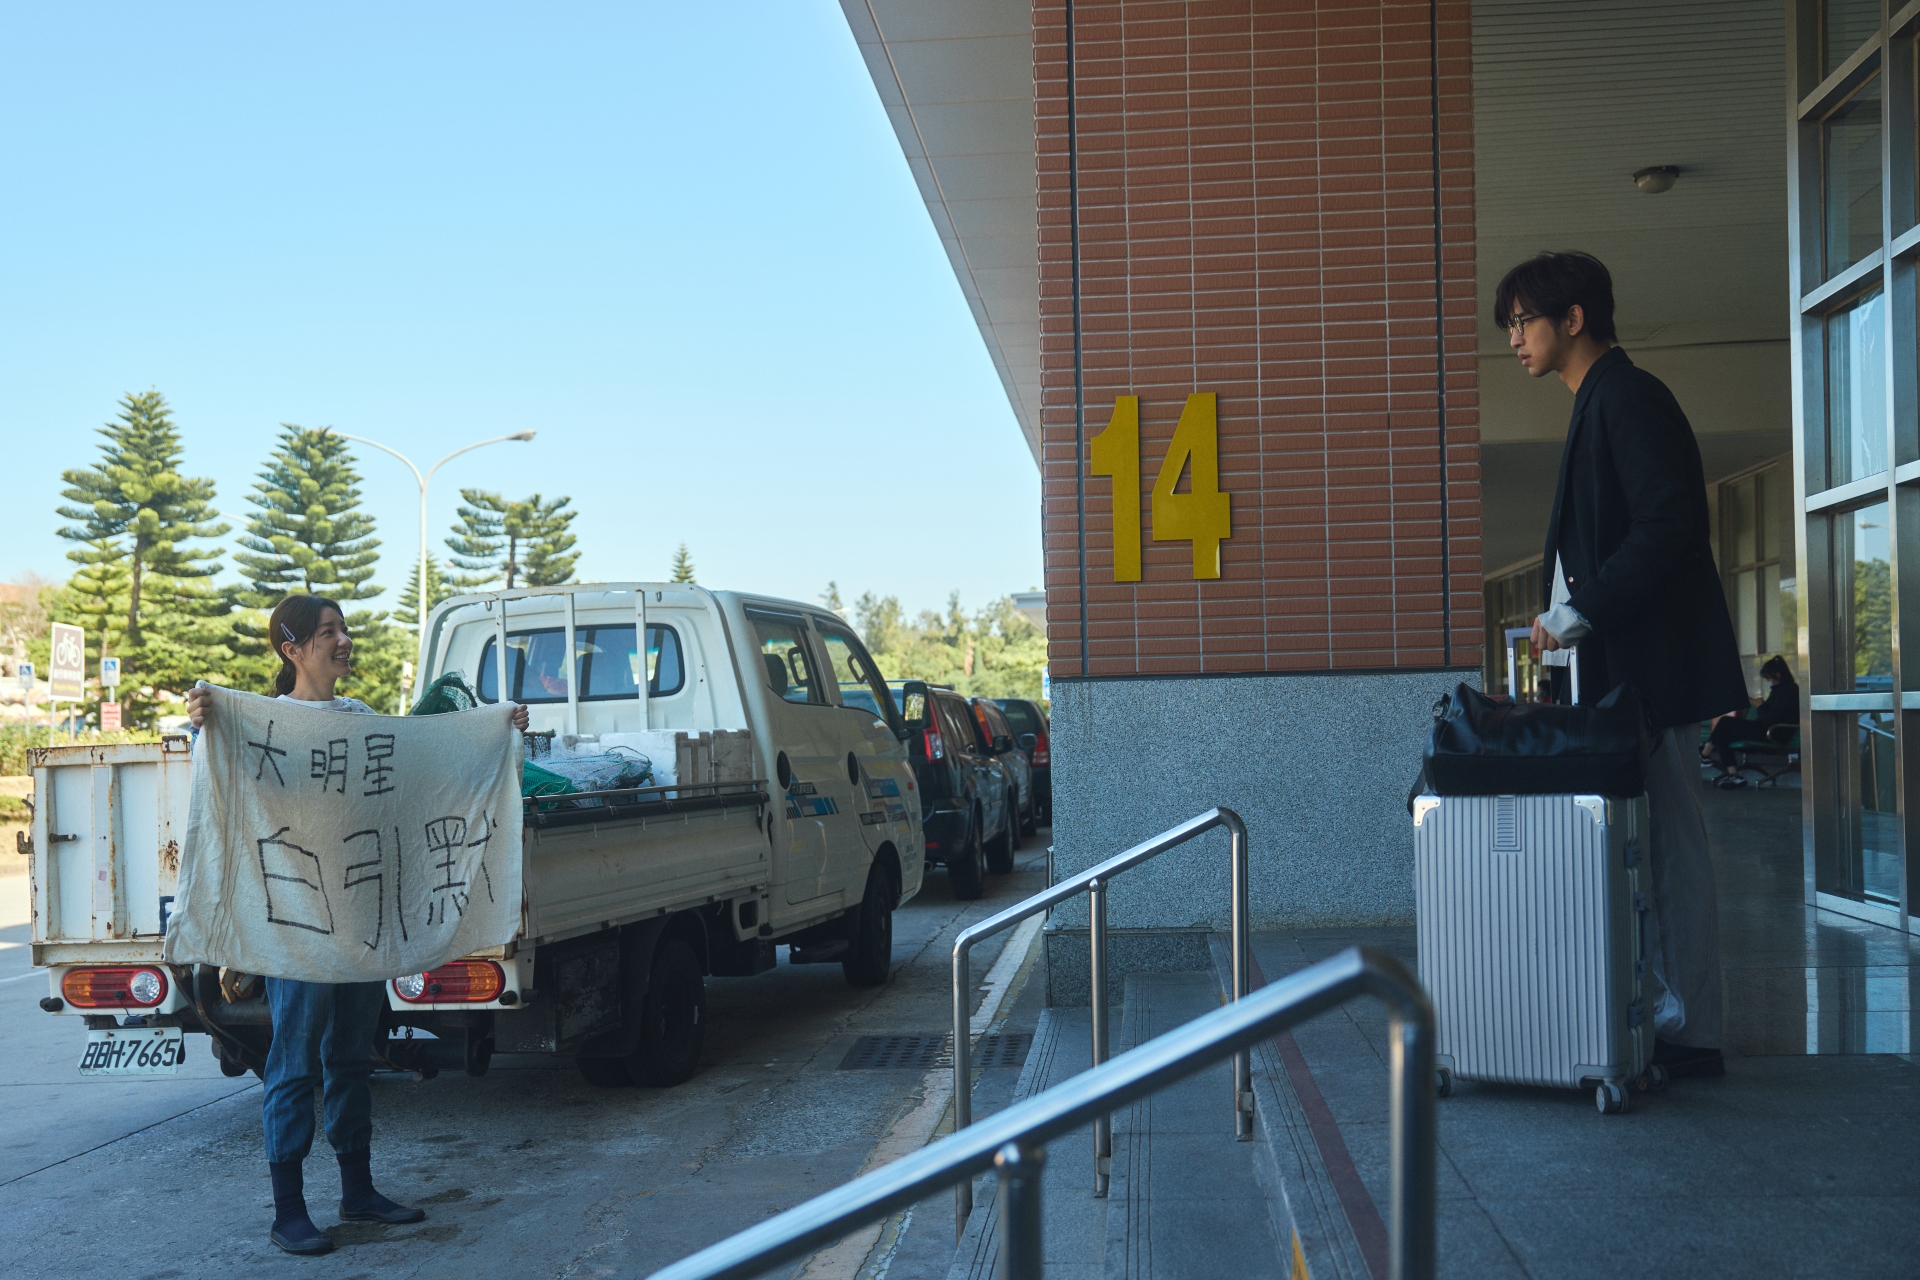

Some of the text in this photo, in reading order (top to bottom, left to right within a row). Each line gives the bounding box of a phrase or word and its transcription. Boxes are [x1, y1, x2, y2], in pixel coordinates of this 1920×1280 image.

[1090, 391, 1231, 582] 14
[248, 719, 395, 797] 大明星
